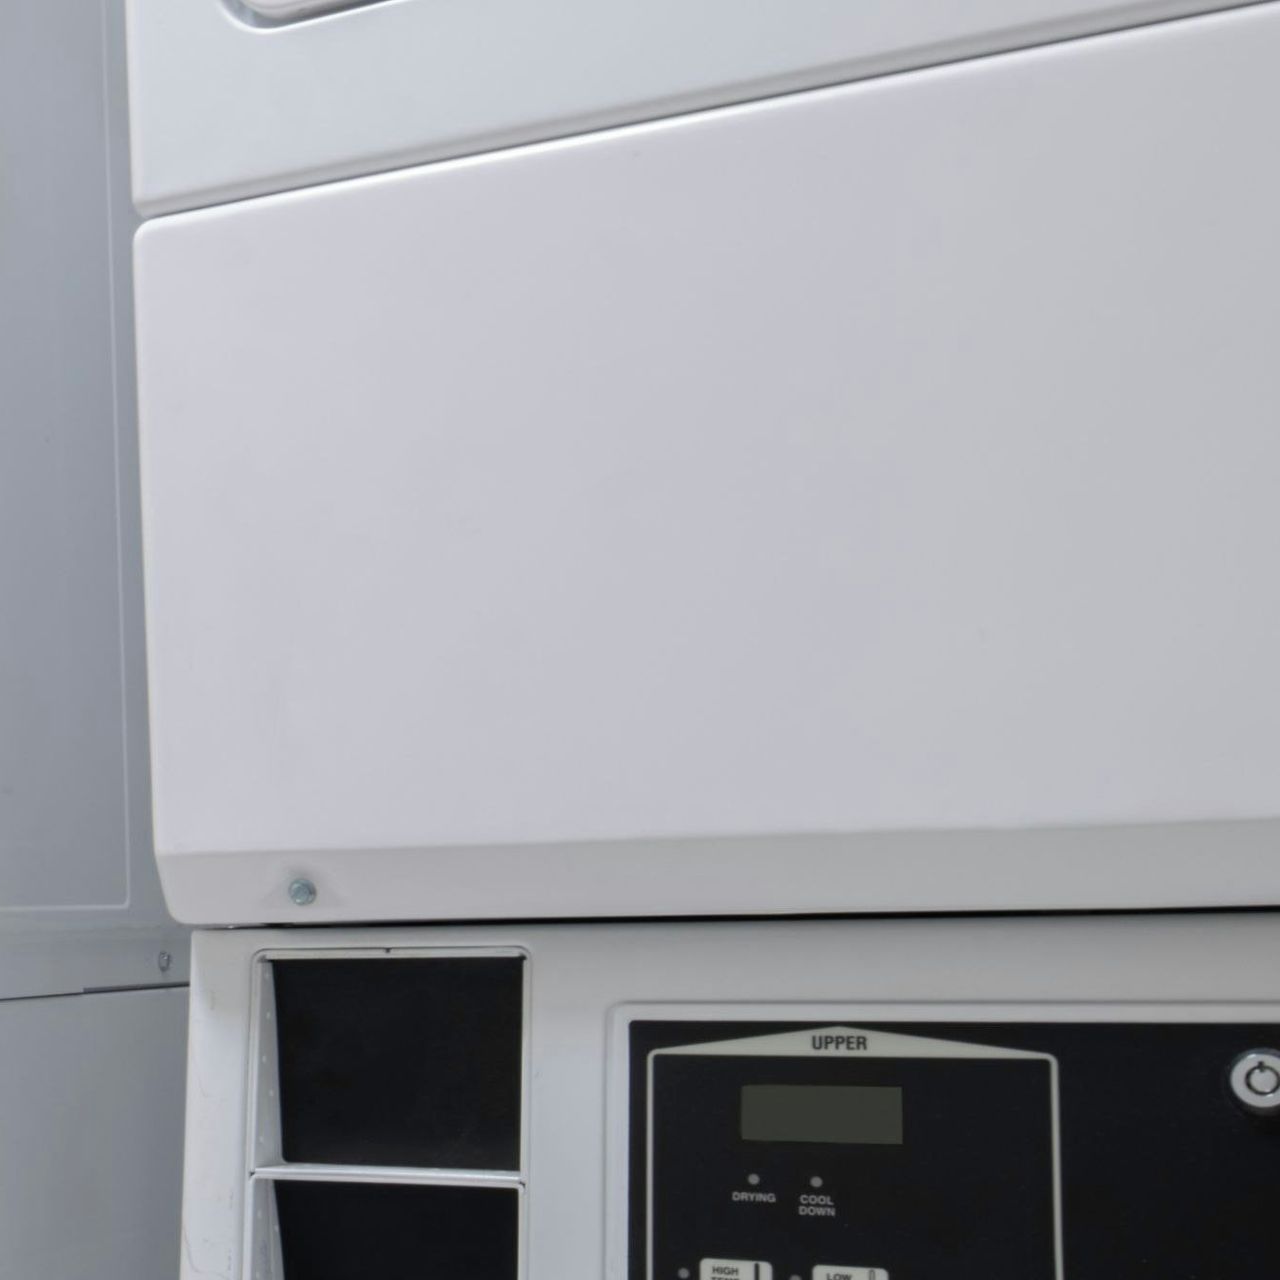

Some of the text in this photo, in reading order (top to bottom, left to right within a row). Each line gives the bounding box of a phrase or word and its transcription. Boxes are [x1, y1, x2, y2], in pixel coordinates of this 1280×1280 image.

[812, 1035, 868, 1051] UPPER
[732, 1191, 776, 1203] DRYING
[800, 1195, 834, 1206] COOL
[798, 1205, 836, 1216] DOWN
[712, 1266, 739, 1276] HIGH
